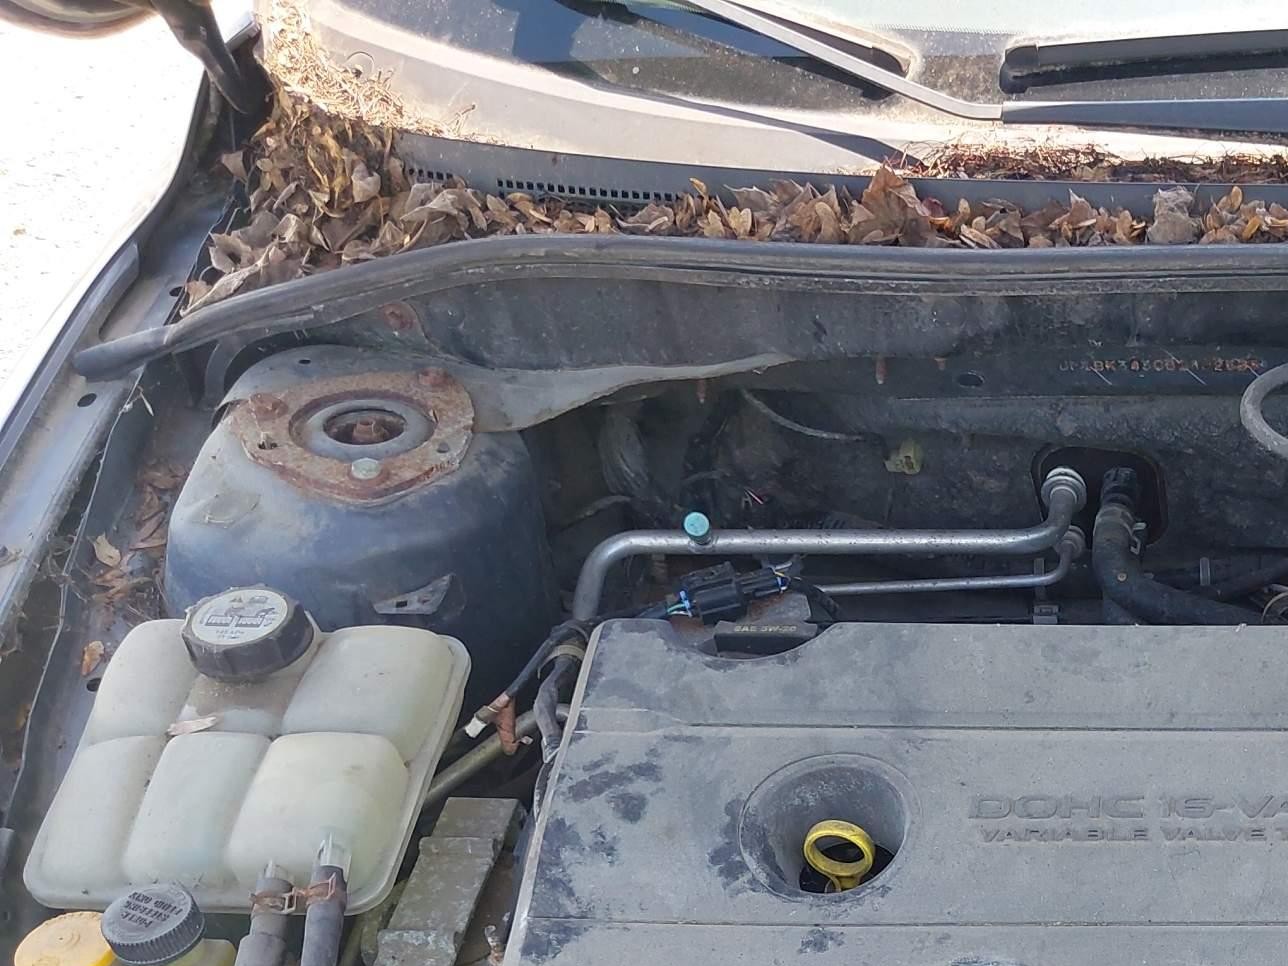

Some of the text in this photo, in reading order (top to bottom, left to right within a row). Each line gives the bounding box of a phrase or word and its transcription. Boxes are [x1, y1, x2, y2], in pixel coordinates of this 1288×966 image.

[968, 794, 1145, 819] DOHC
[979, 827, 1150, 844] VARIABLE
[1160, 827, 1268, 843] VALVE
